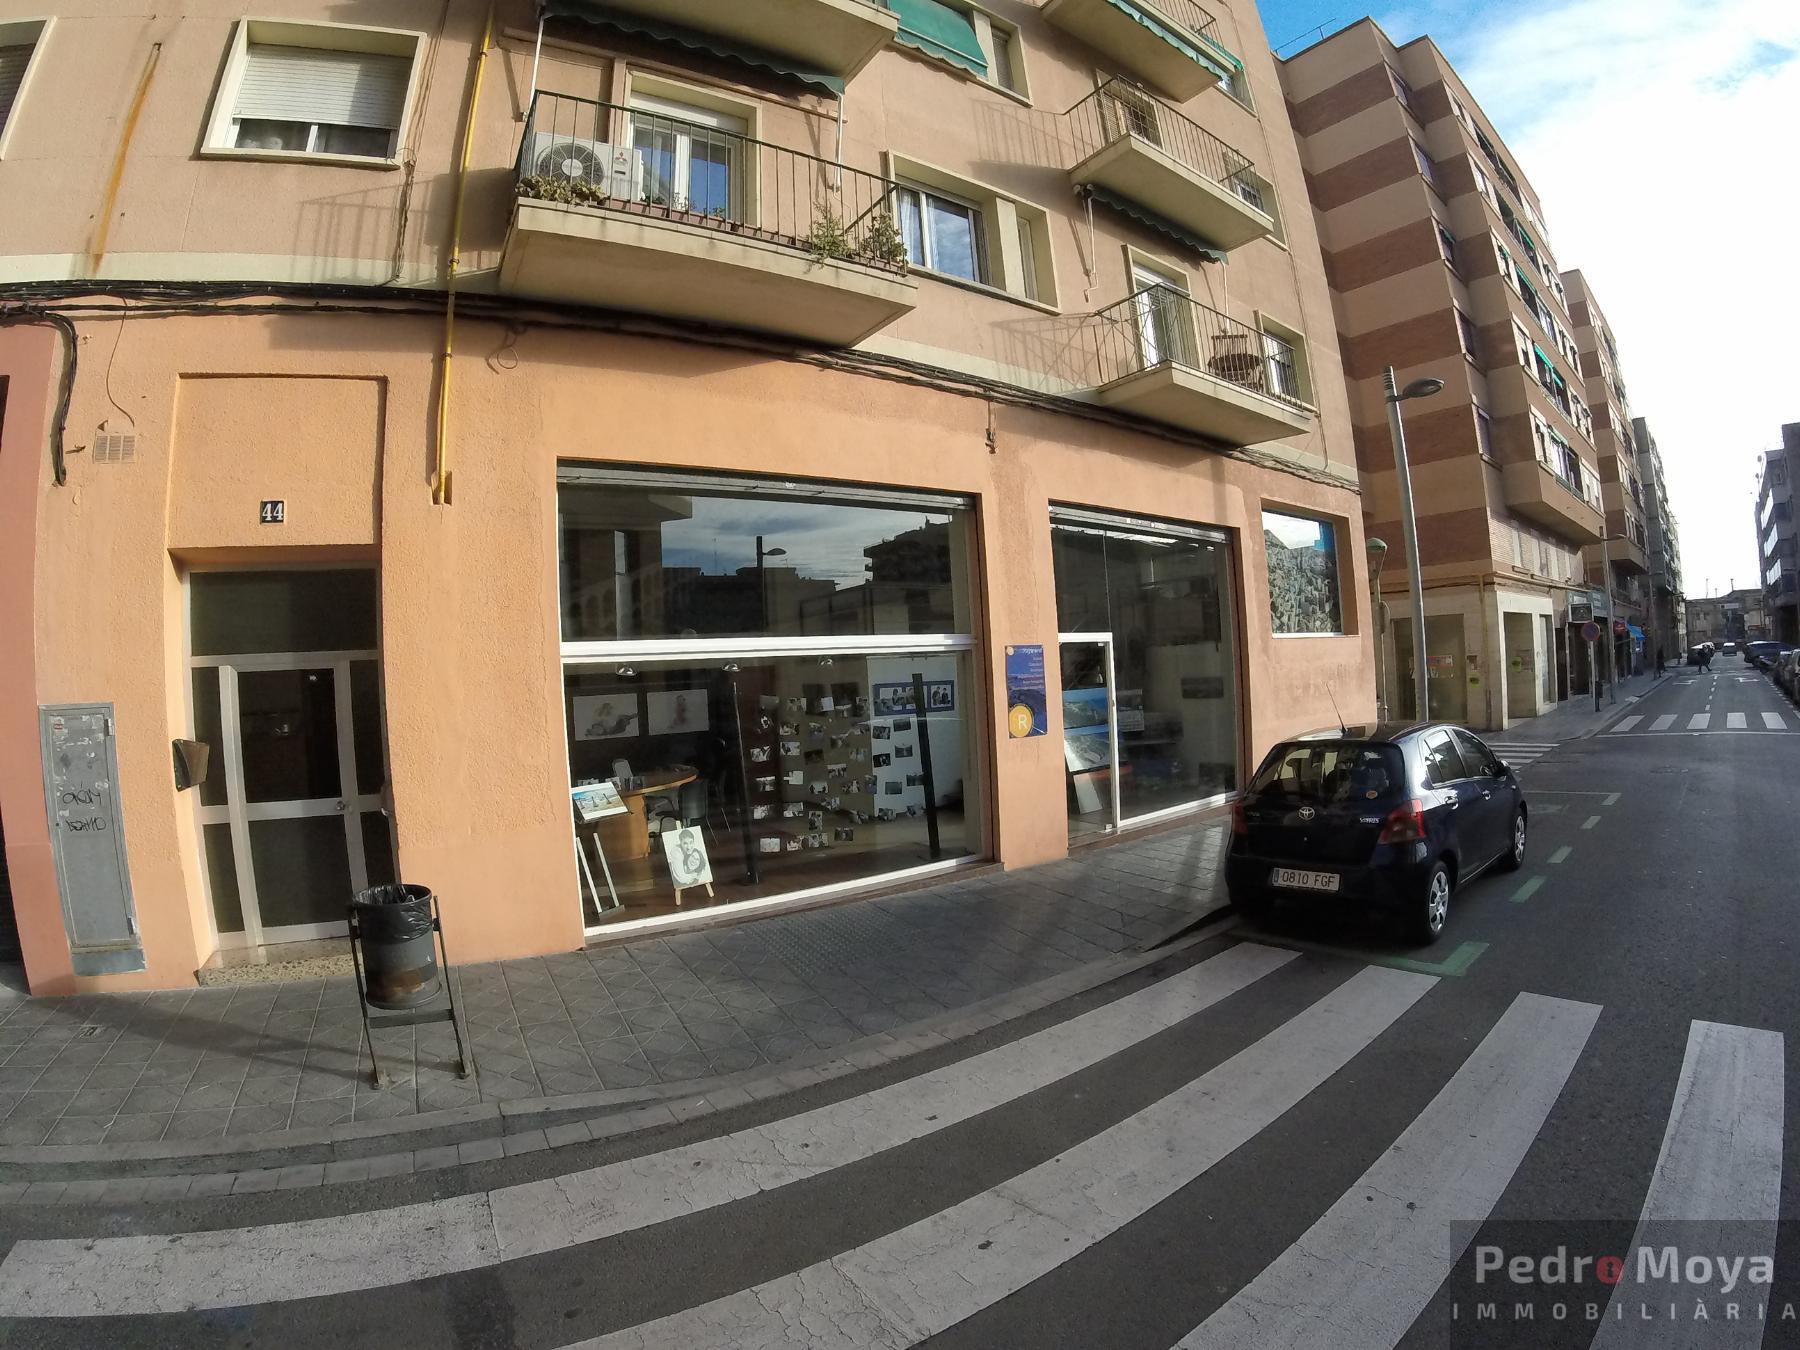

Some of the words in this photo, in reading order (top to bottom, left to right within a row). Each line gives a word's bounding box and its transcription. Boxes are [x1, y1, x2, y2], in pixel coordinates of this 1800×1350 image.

[262, 503, 284, 521] 44
[1282, 871, 1309, 885] 0810
[1313, 874, 1336, 888] FGF
